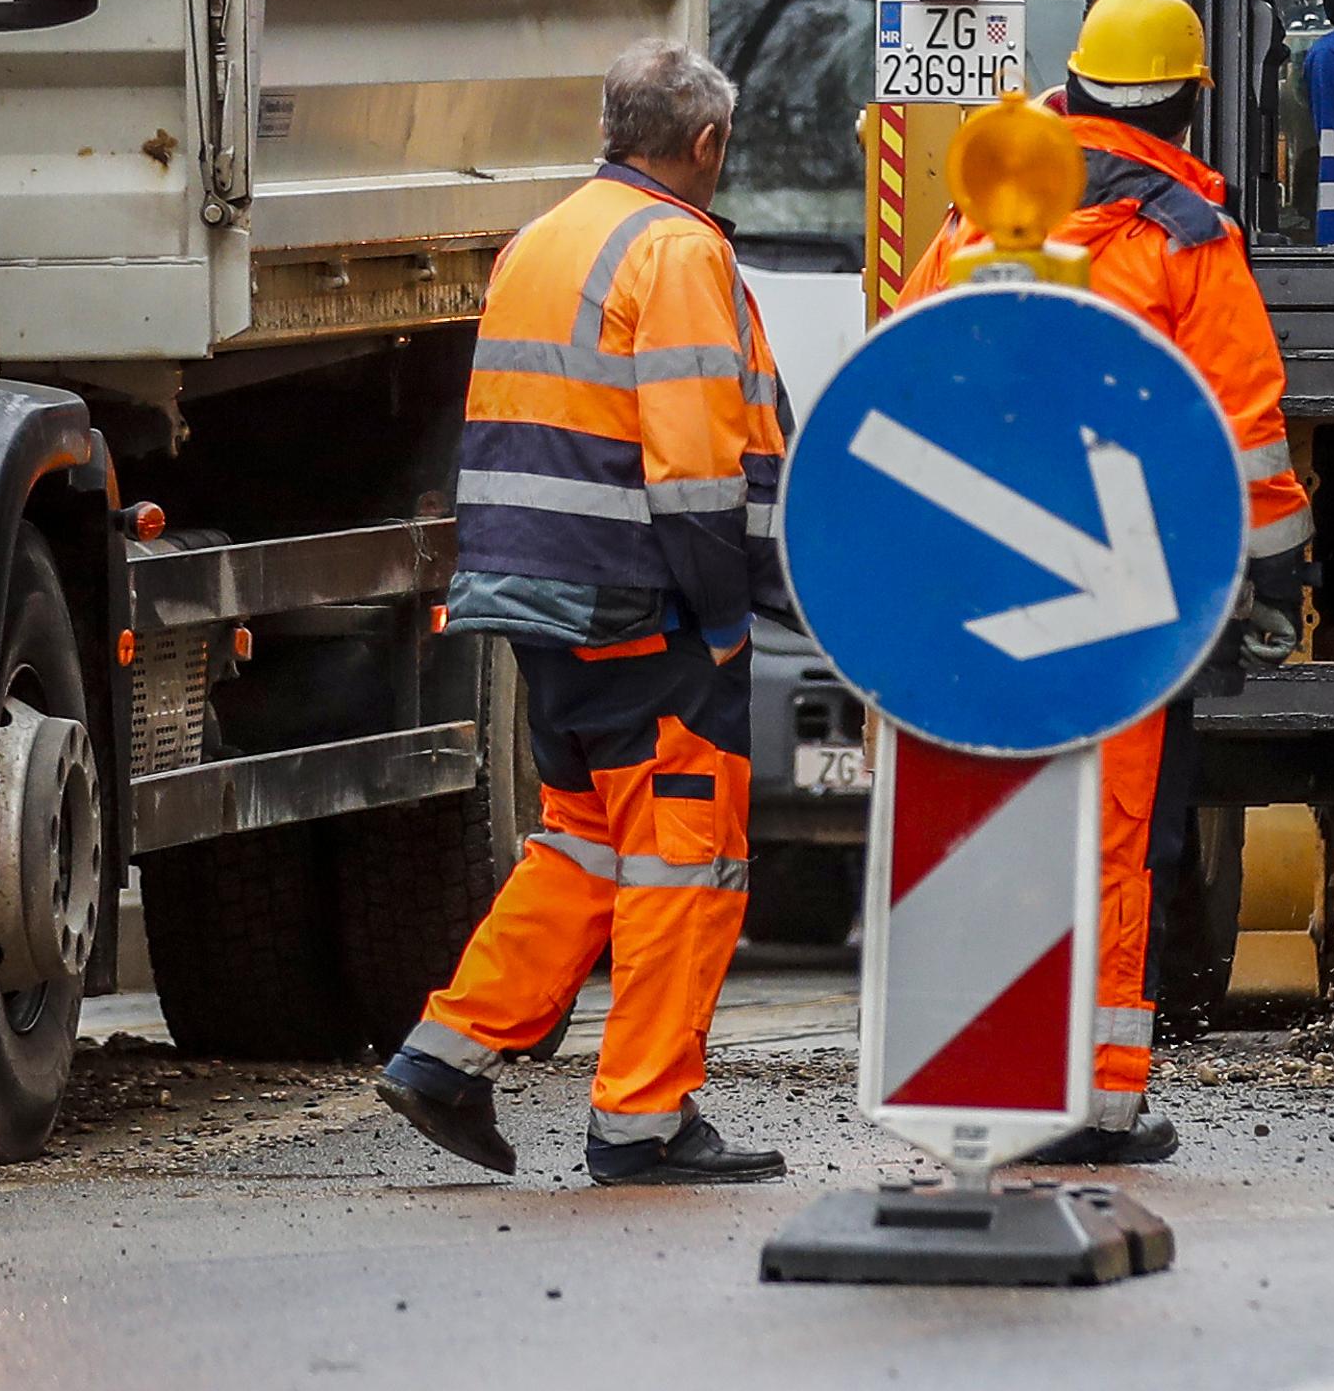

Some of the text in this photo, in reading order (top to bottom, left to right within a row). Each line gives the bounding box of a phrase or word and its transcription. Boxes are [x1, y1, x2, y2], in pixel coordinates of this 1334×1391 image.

[880, 30, 900, 44] HR
[925, 6, 977, 50] ZG
[882, 53, 1019, 96] 2369-HC
[819, 751, 857, 785] ZG
